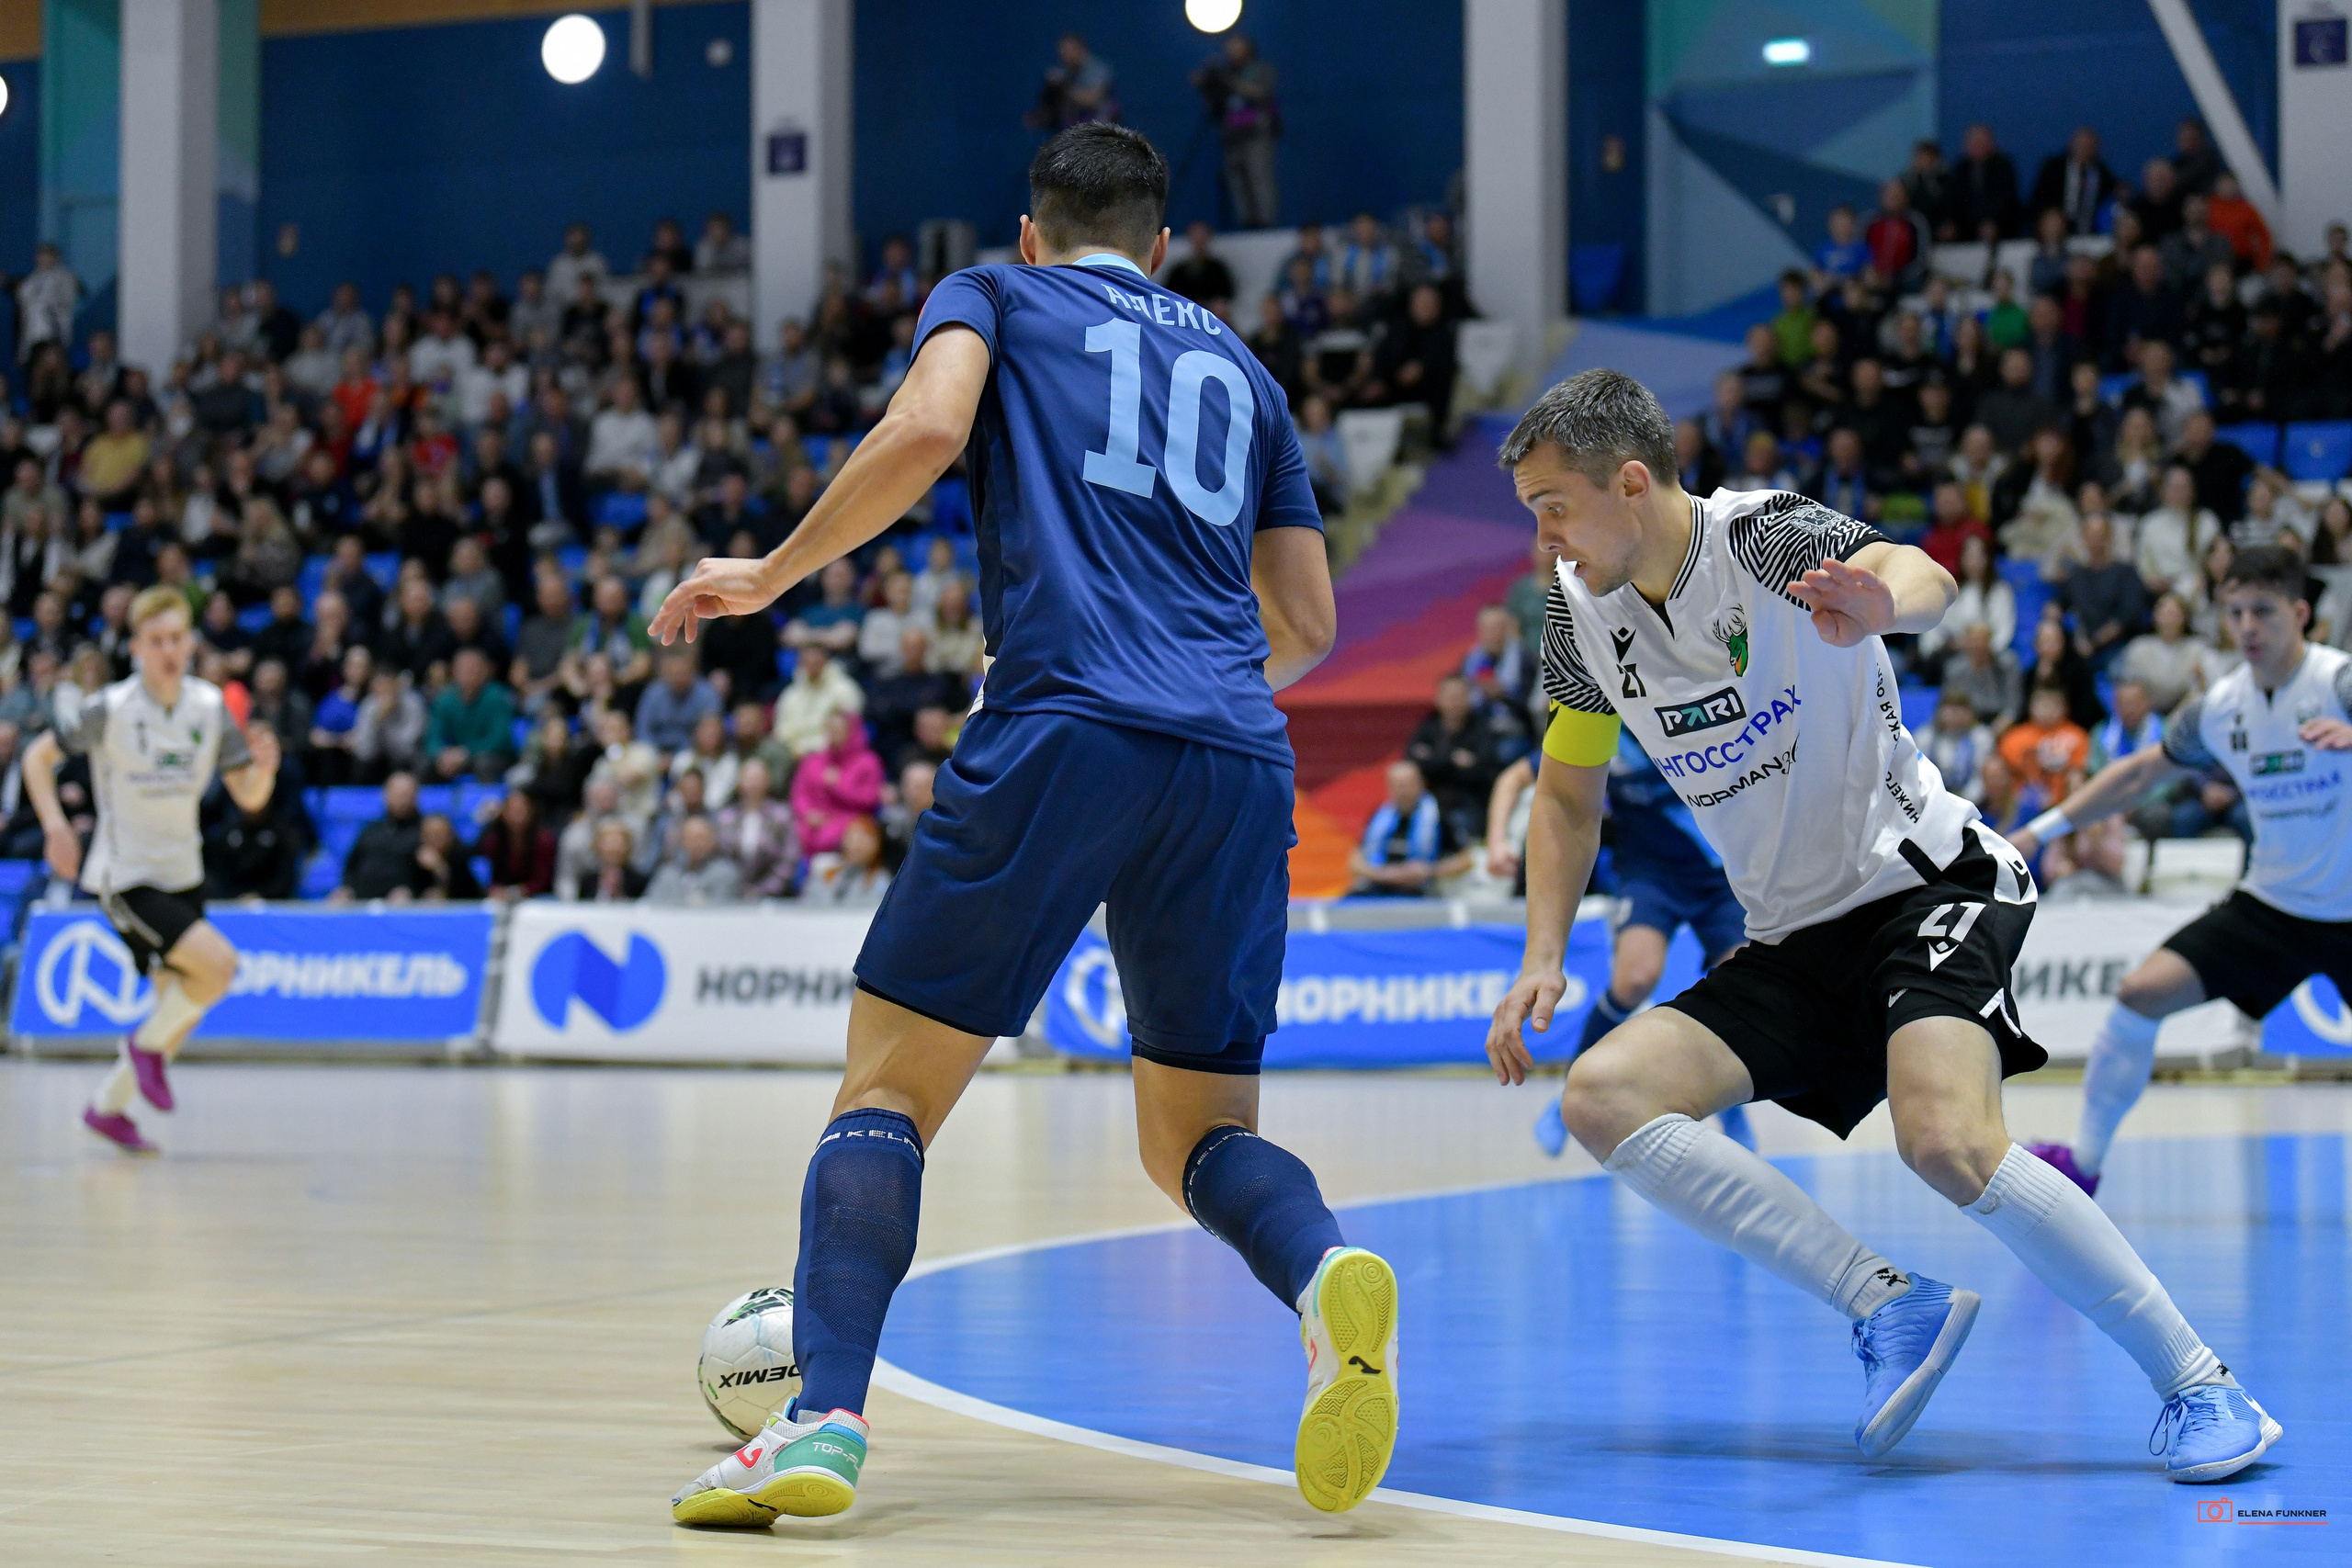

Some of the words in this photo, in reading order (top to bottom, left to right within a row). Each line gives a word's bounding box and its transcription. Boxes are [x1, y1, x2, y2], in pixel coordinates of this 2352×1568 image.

[1101, 283, 1222, 336] АЛЕКС
[1082, 317, 1255, 526] 10
[1616, 663, 1647, 699] 21
[1661, 694, 1741, 731] PARI
[1917, 902, 1987, 943] 21
[229, 950, 469, 998] ОРНИКЕЛЬ
[696, 966, 857, 1007] НОРНИ
[1277, 969, 1589, 1026] ОРНИКЕЬ
